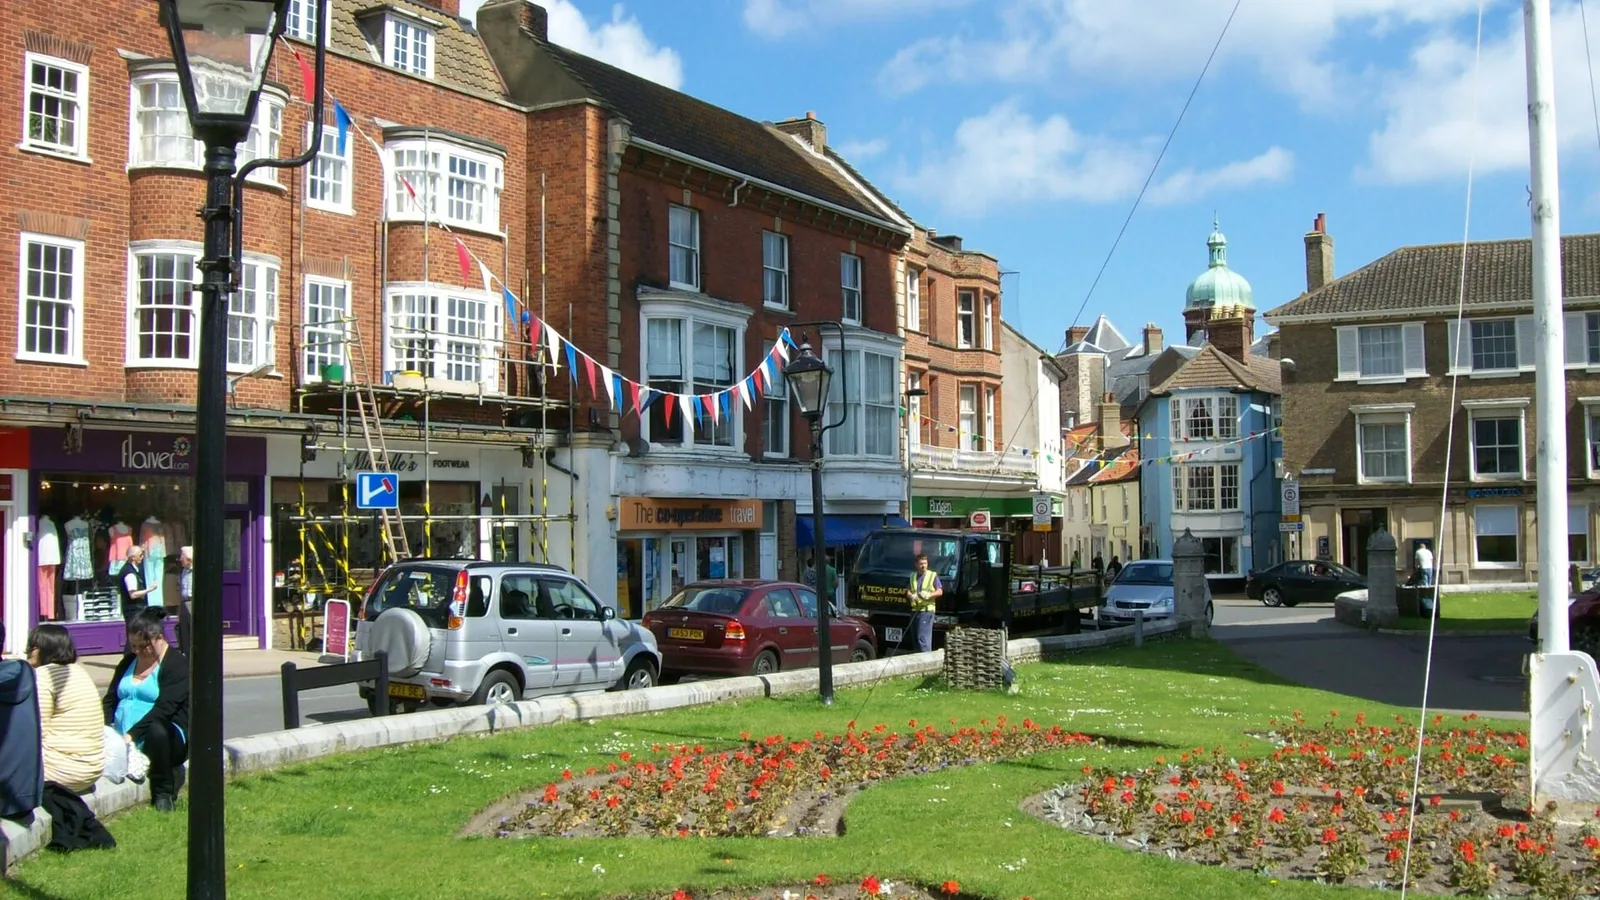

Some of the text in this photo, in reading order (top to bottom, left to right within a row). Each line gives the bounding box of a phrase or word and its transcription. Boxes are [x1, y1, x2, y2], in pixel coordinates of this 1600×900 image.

[433, 459, 470, 469] FOOTWEAR
[634, 502, 653, 524] The
[730, 503, 755, 524] travel
[858, 584, 865, 593] H
[866, 585, 886, 594] TECH
